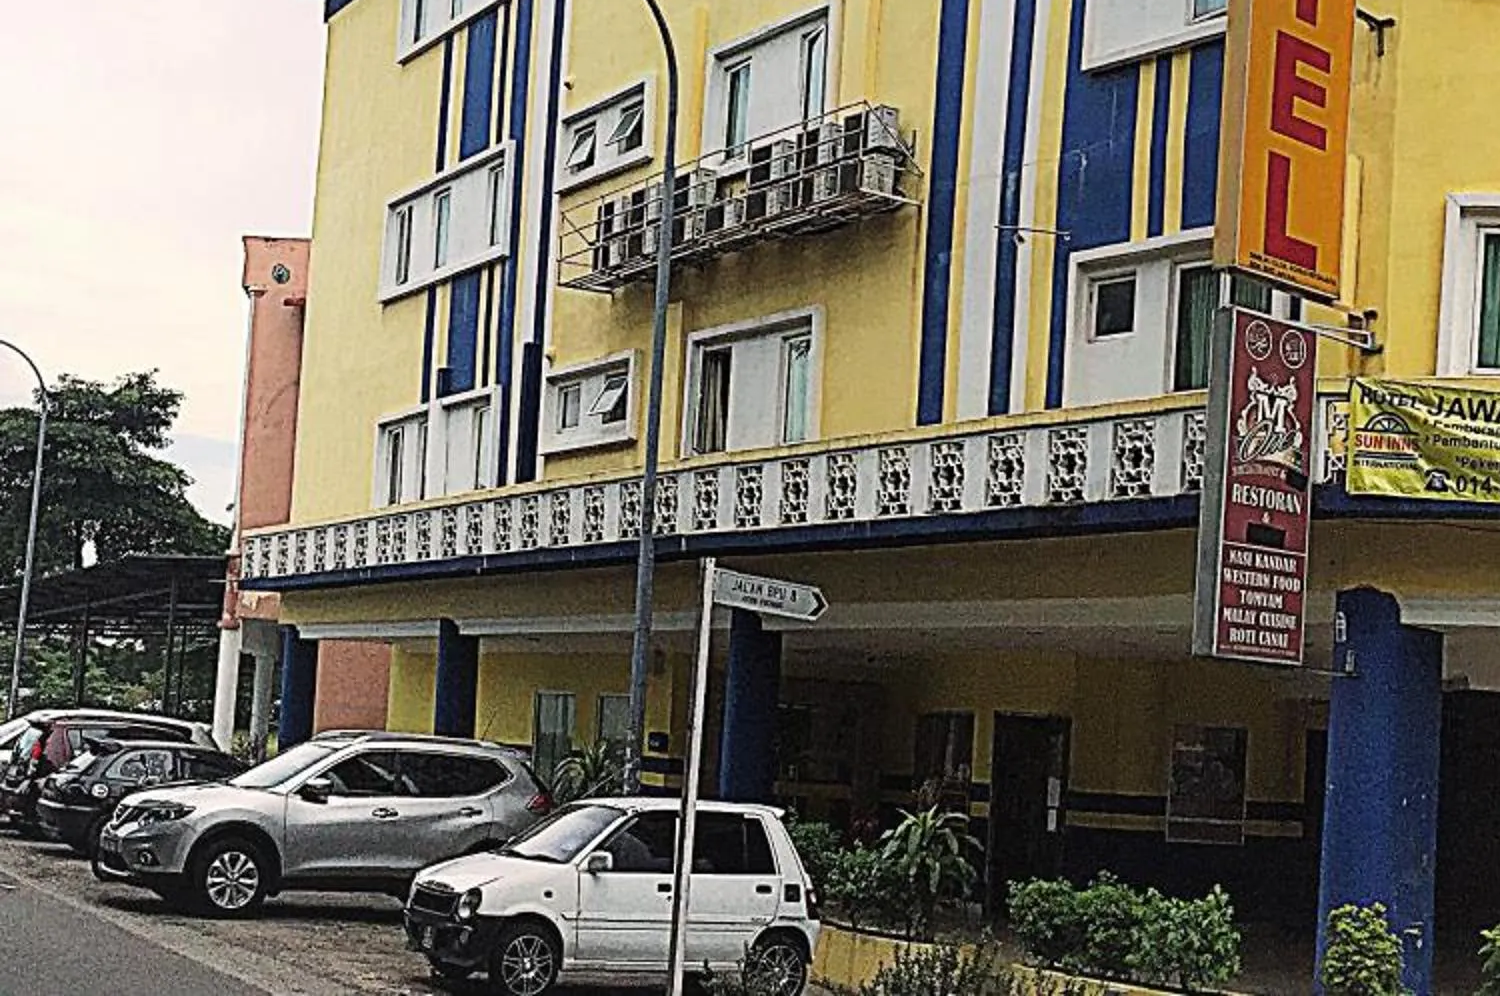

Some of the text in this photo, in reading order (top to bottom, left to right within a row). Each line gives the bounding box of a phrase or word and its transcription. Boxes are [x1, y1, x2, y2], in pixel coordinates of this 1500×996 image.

[1356, 435, 1420, 451] SUN INNS
[1232, 483, 1302, 515] RESTORAN
[1229, 549, 1297, 573] NASI KANDAR
[1223, 567, 1300, 593] WESTERN FOOD
[1223, 607, 1257, 625] MALAY
[1229, 627, 1256, 644] ROTI
